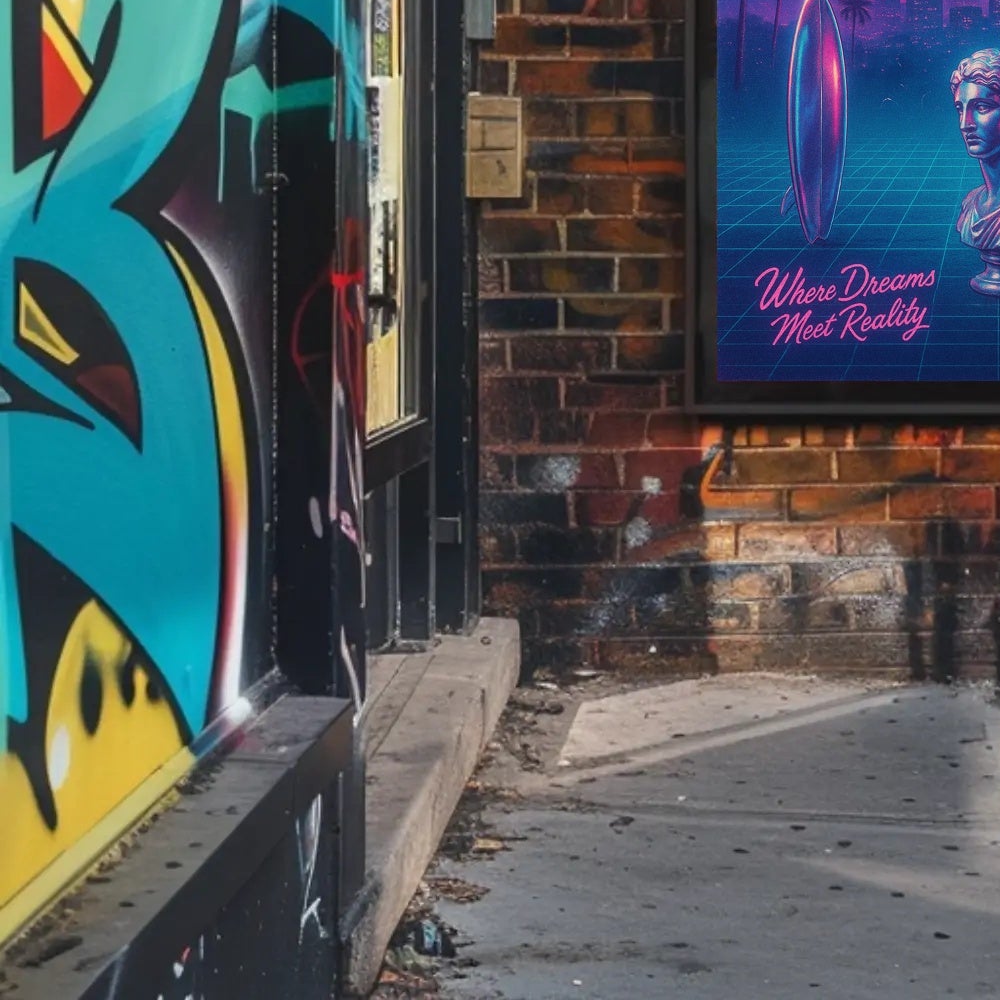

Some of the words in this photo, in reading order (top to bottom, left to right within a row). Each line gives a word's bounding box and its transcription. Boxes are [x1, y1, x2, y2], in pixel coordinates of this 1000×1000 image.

[754, 266, 837, 311] Where
[838, 263, 936, 302] Dreams
[770, 309, 838, 346] Meet
[838, 297, 931, 342] Reality
